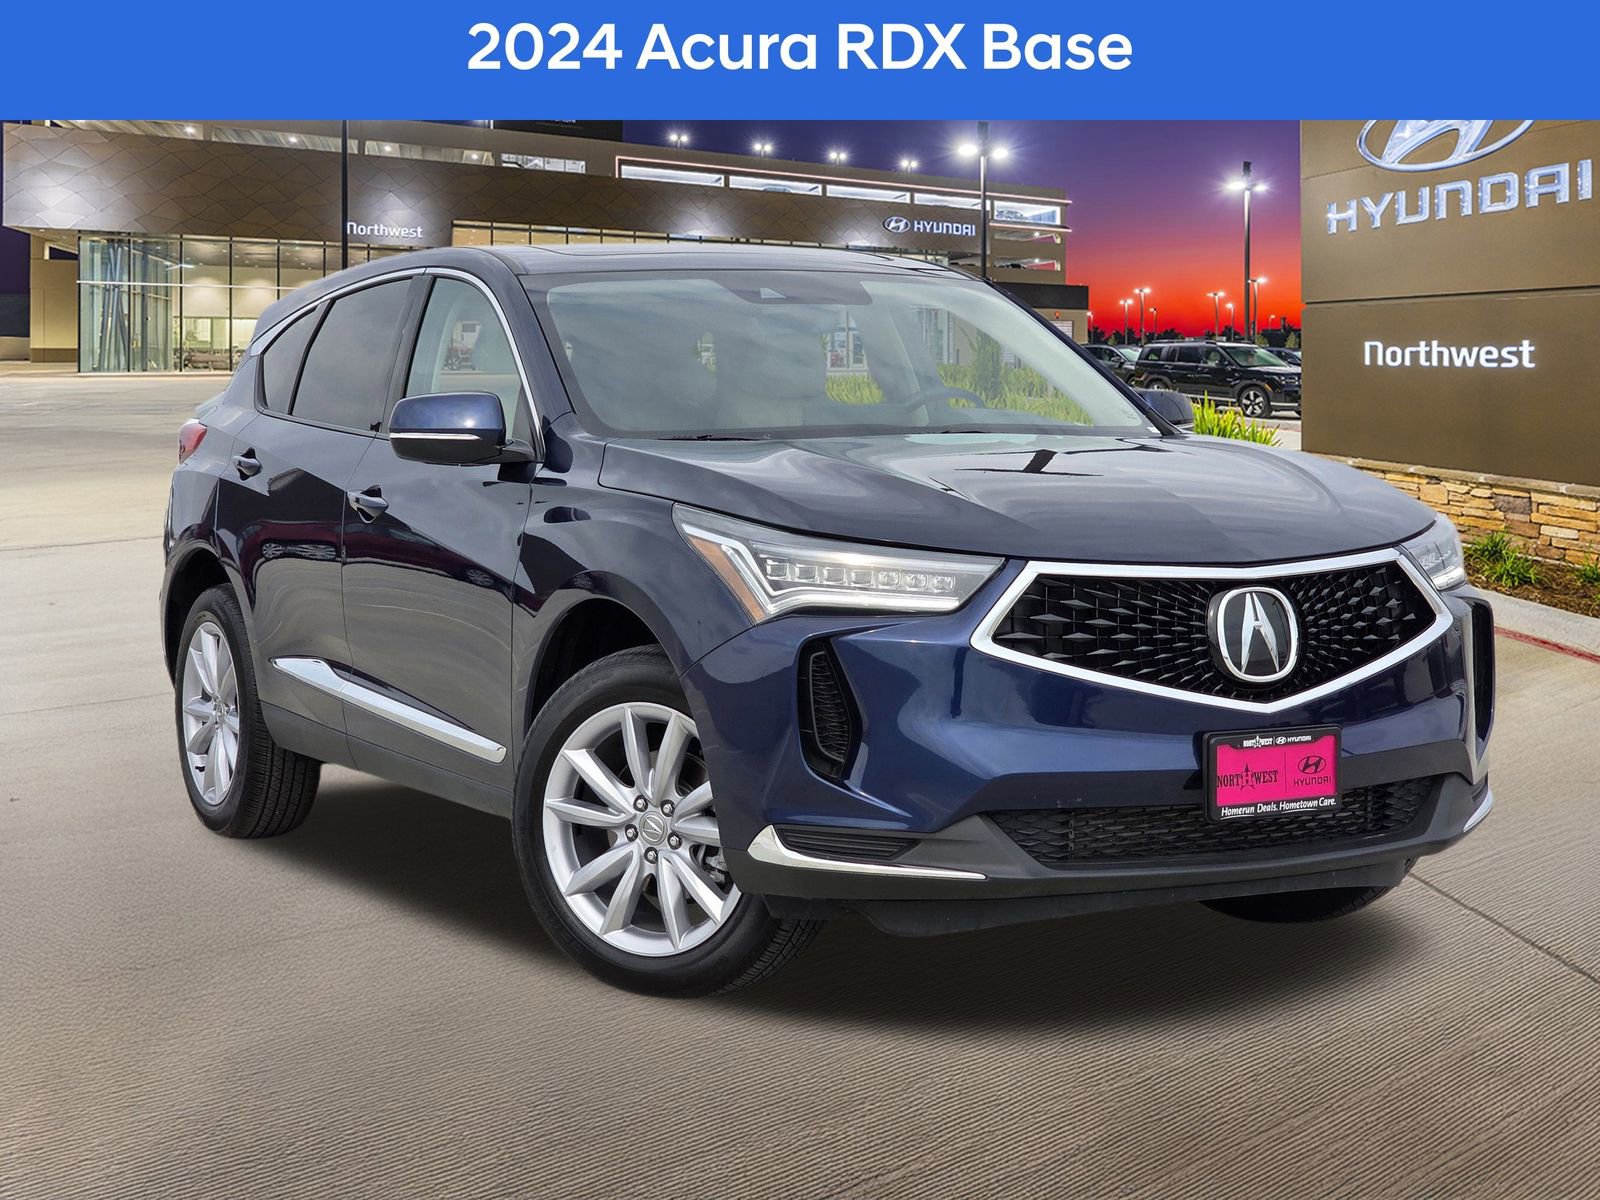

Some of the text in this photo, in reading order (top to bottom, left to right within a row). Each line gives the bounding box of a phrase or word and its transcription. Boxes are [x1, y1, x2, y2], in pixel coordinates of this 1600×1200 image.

[1326, 159, 1593, 235] HYUNDAI
[347, 221, 424, 238] Northwest
[913, 219, 977, 236] HYUNDAI
[1363, 339, 1536, 368] Northwest
[1293, 775, 1332, 786] HYUNDAI
[1221, 804, 1255, 817] Homerun
[1279, 799, 1318, 811] Hometown
[1318, 797, 1337, 808] Care.
